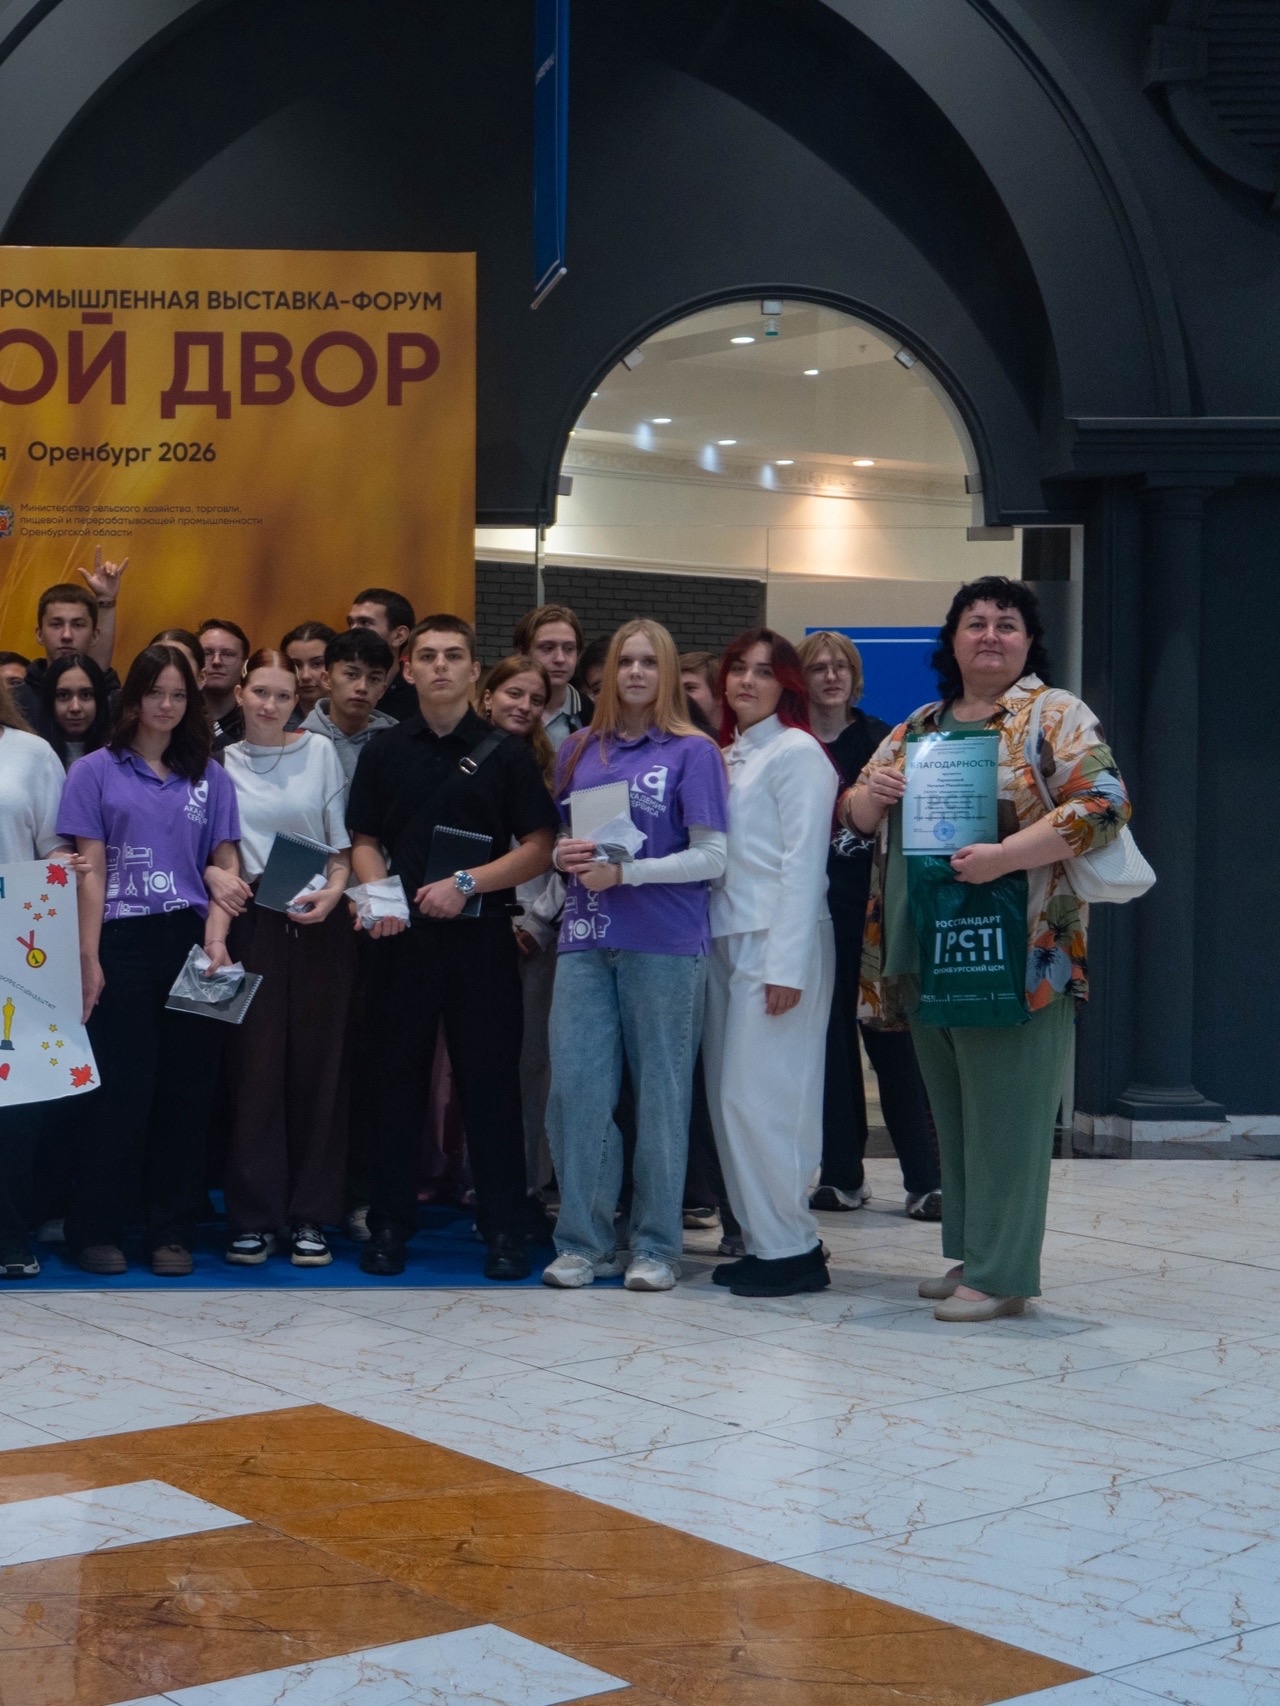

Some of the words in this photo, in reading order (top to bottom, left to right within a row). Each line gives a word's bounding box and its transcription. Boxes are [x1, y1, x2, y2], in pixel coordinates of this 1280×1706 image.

[207, 290, 443, 312] ВЫСТАВКА-ФОРУМ
[160, 330, 441, 420] ДВОР
[27, 441, 152, 467] Оренбург
[158, 442, 217, 463] 2026
[19, 503, 91, 514] Министерство
[177, 517, 263, 526] промышленности
[19, 527, 91, 538] Оренбургской
[92, 527, 133, 537] области
[910, 759, 996, 770] БЛАГОДАРНОСТЬ
[630, 792, 667, 813] КАДЕМИЯ
[631, 800, 659, 818] ЕРВИСА
